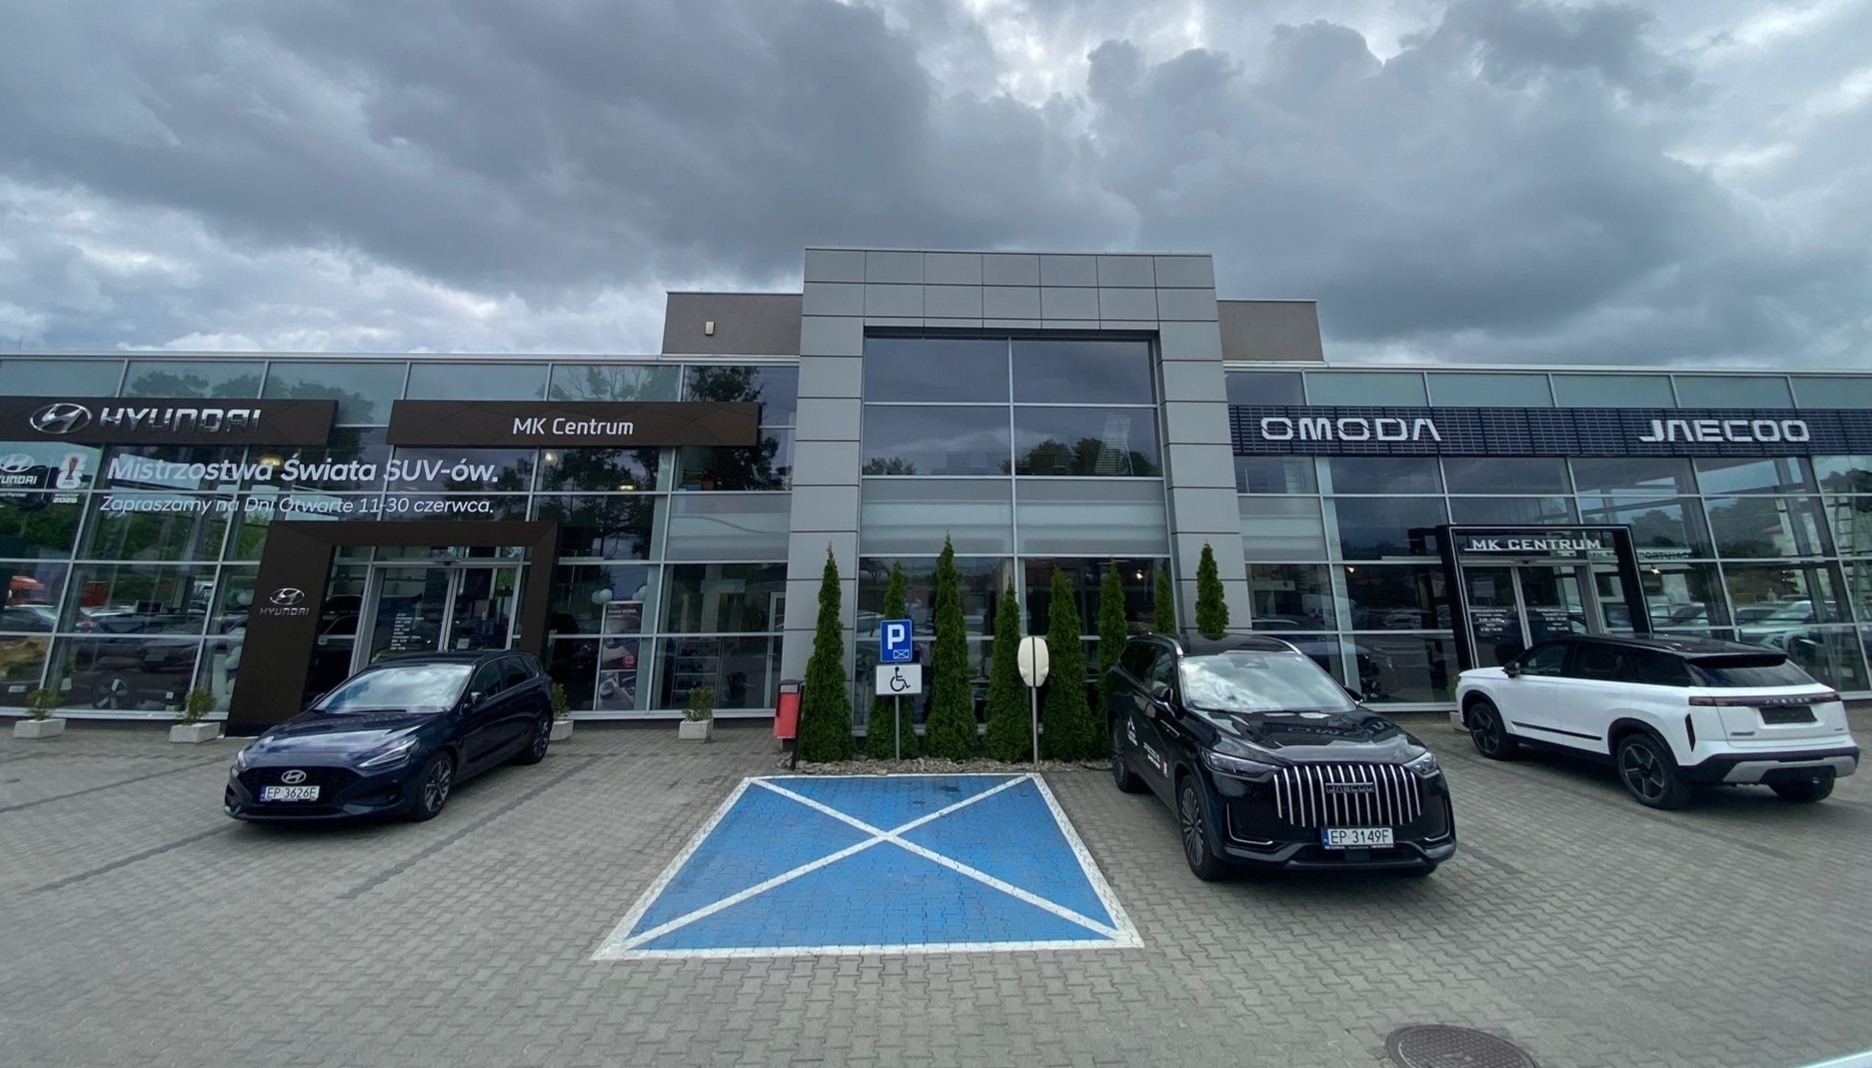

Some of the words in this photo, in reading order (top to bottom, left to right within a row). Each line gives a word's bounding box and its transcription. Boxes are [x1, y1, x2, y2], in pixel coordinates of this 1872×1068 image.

[99, 407, 261, 432] HYUNDAI
[512, 417, 547, 435] MK
[552, 417, 634, 435] Centrum
[1260, 417, 1442, 441] OMODA
[1638, 419, 1810, 442] JAECOO
[107, 457, 273, 481] Mistrzostwa
[281, 453, 377, 481] Świata
[383, 458, 499, 483] SUV-ów.
[100, 496, 212, 515] Zapraszamy
[215, 499, 240, 512] na
[244, 497, 275, 512] Dni
[279, 497, 354, 513] Otwarte
[358, 497, 410, 513] 11-30
[413, 499, 494, 514] czerwca.
[1472, 539, 1501, 550] MK
[1507, 539, 1602, 550] CENTRUM
[259, 607, 310, 616] HYUNDAI
[887, 624, 905, 650] P
[267, 787, 281, 798] EP
[284, 786, 317, 798] 3626E
[1330, 830, 1347, 844] EP
[1351, 830, 1389, 843] 3149F
